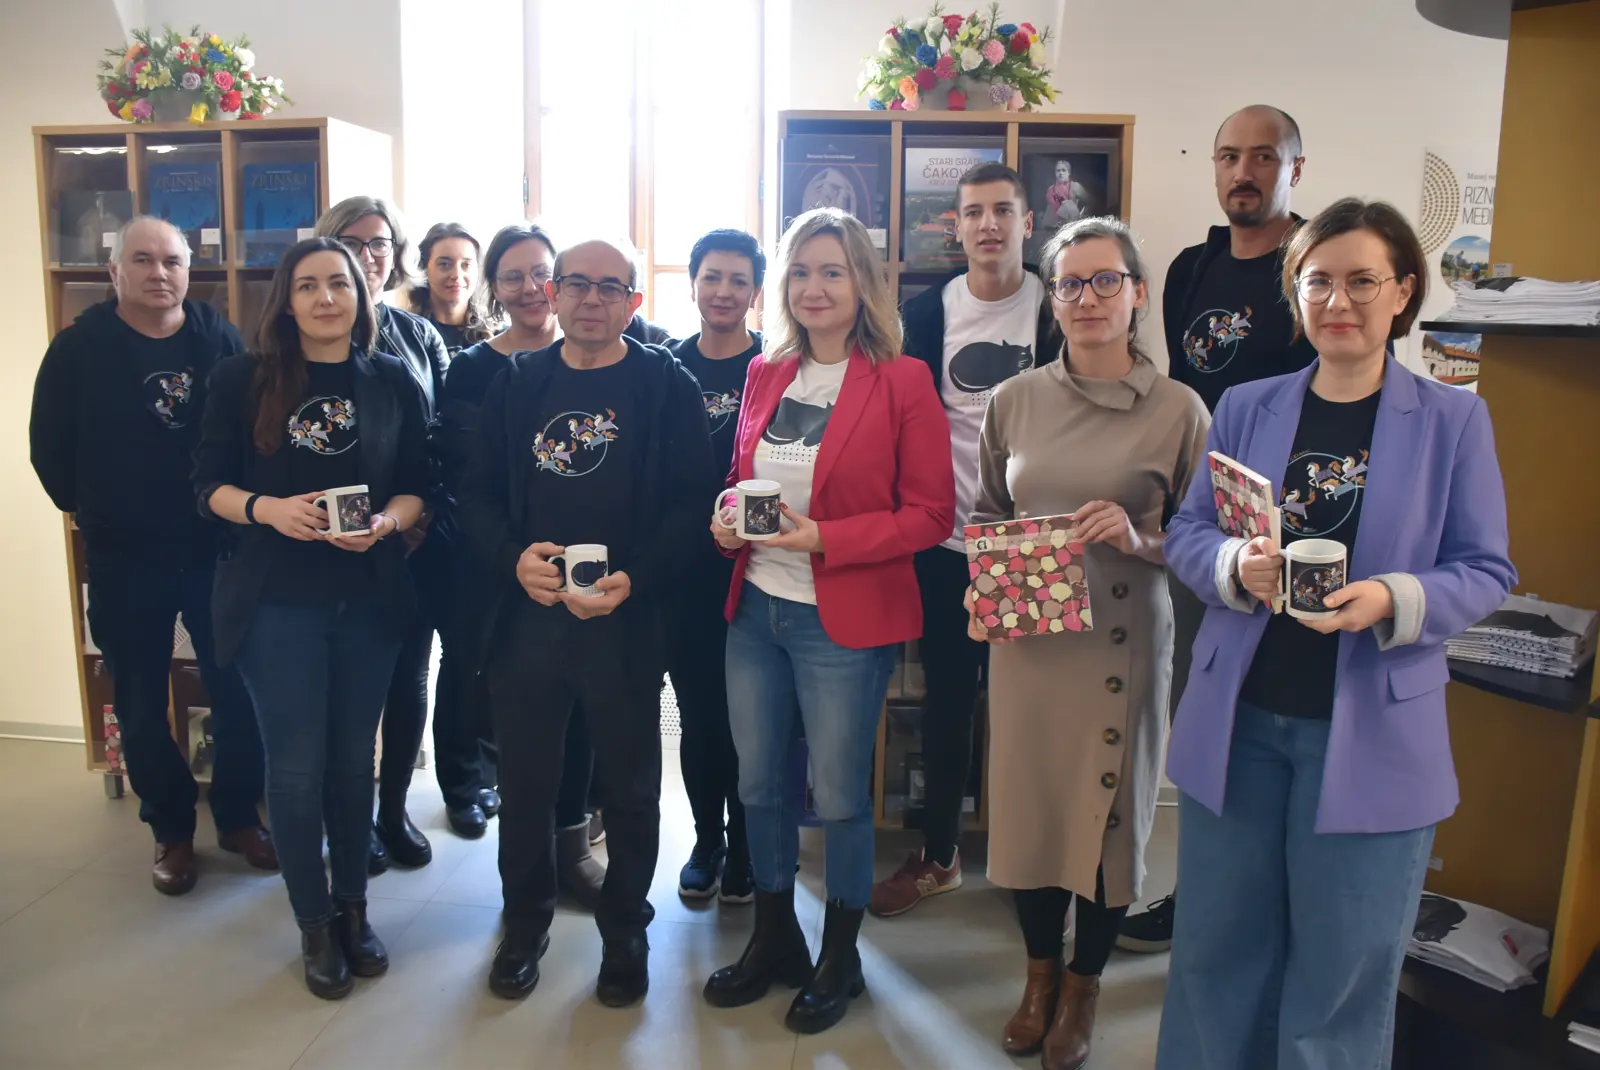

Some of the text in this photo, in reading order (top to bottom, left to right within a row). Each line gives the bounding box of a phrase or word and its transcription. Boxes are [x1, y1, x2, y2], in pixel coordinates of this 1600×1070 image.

[928, 157, 953, 166] STARI
[922, 164, 969, 179] ČAKOV
[1462, 186, 1493, 205] RIZN
[1461, 207, 1492, 225] MEĐI
